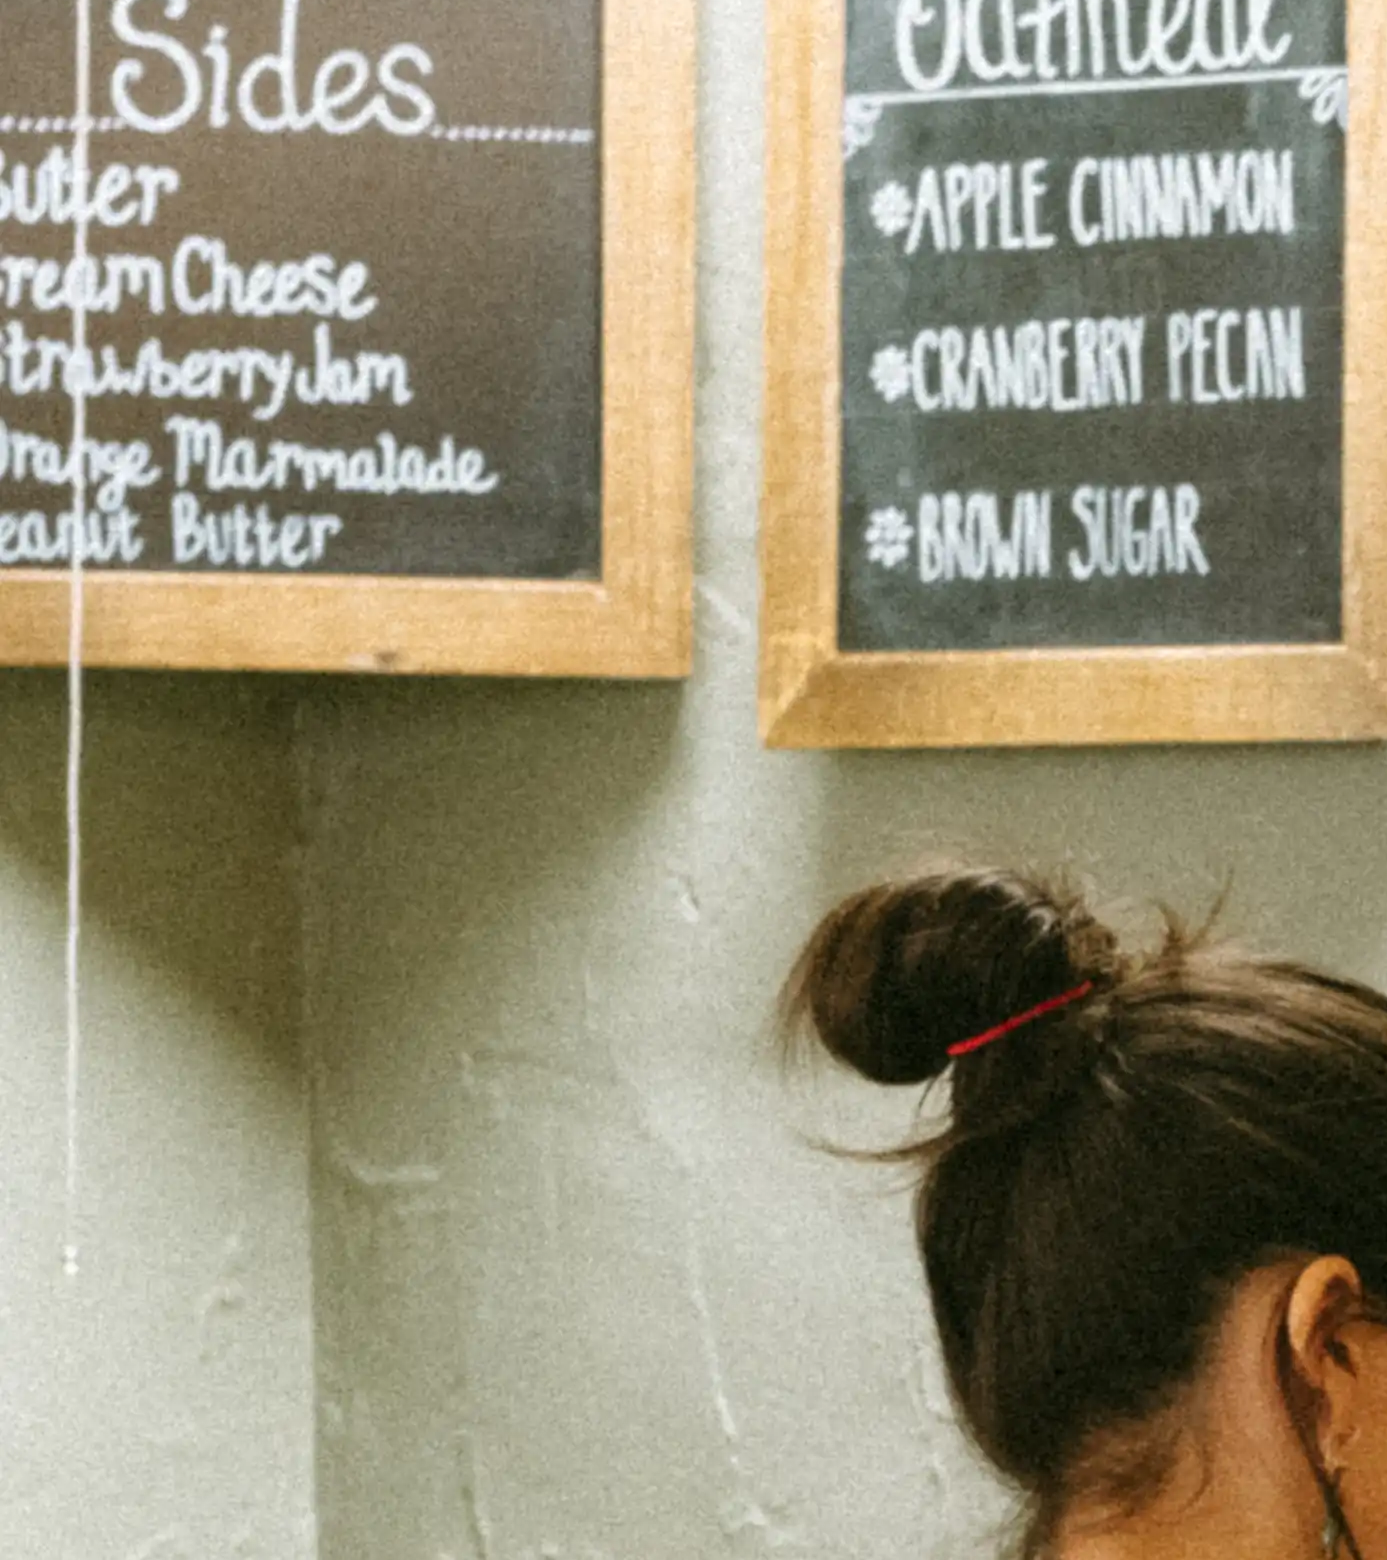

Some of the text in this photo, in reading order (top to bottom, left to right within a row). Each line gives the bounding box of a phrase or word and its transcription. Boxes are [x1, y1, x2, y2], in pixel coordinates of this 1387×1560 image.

[905, 150, 1295, 255] APPLE CINNAMON
[0, 234, 379, 321] ream Cheese
[0, 320, 413, 421] trawberry Jam
[910, 307, 1307, 413] CRANBERRY PECAN
[165, 414, 498, 496] Marmalade
[0, 491, 343, 568] eanut Butter
[918, 484, 1211, 584] BROWN SUGAR
